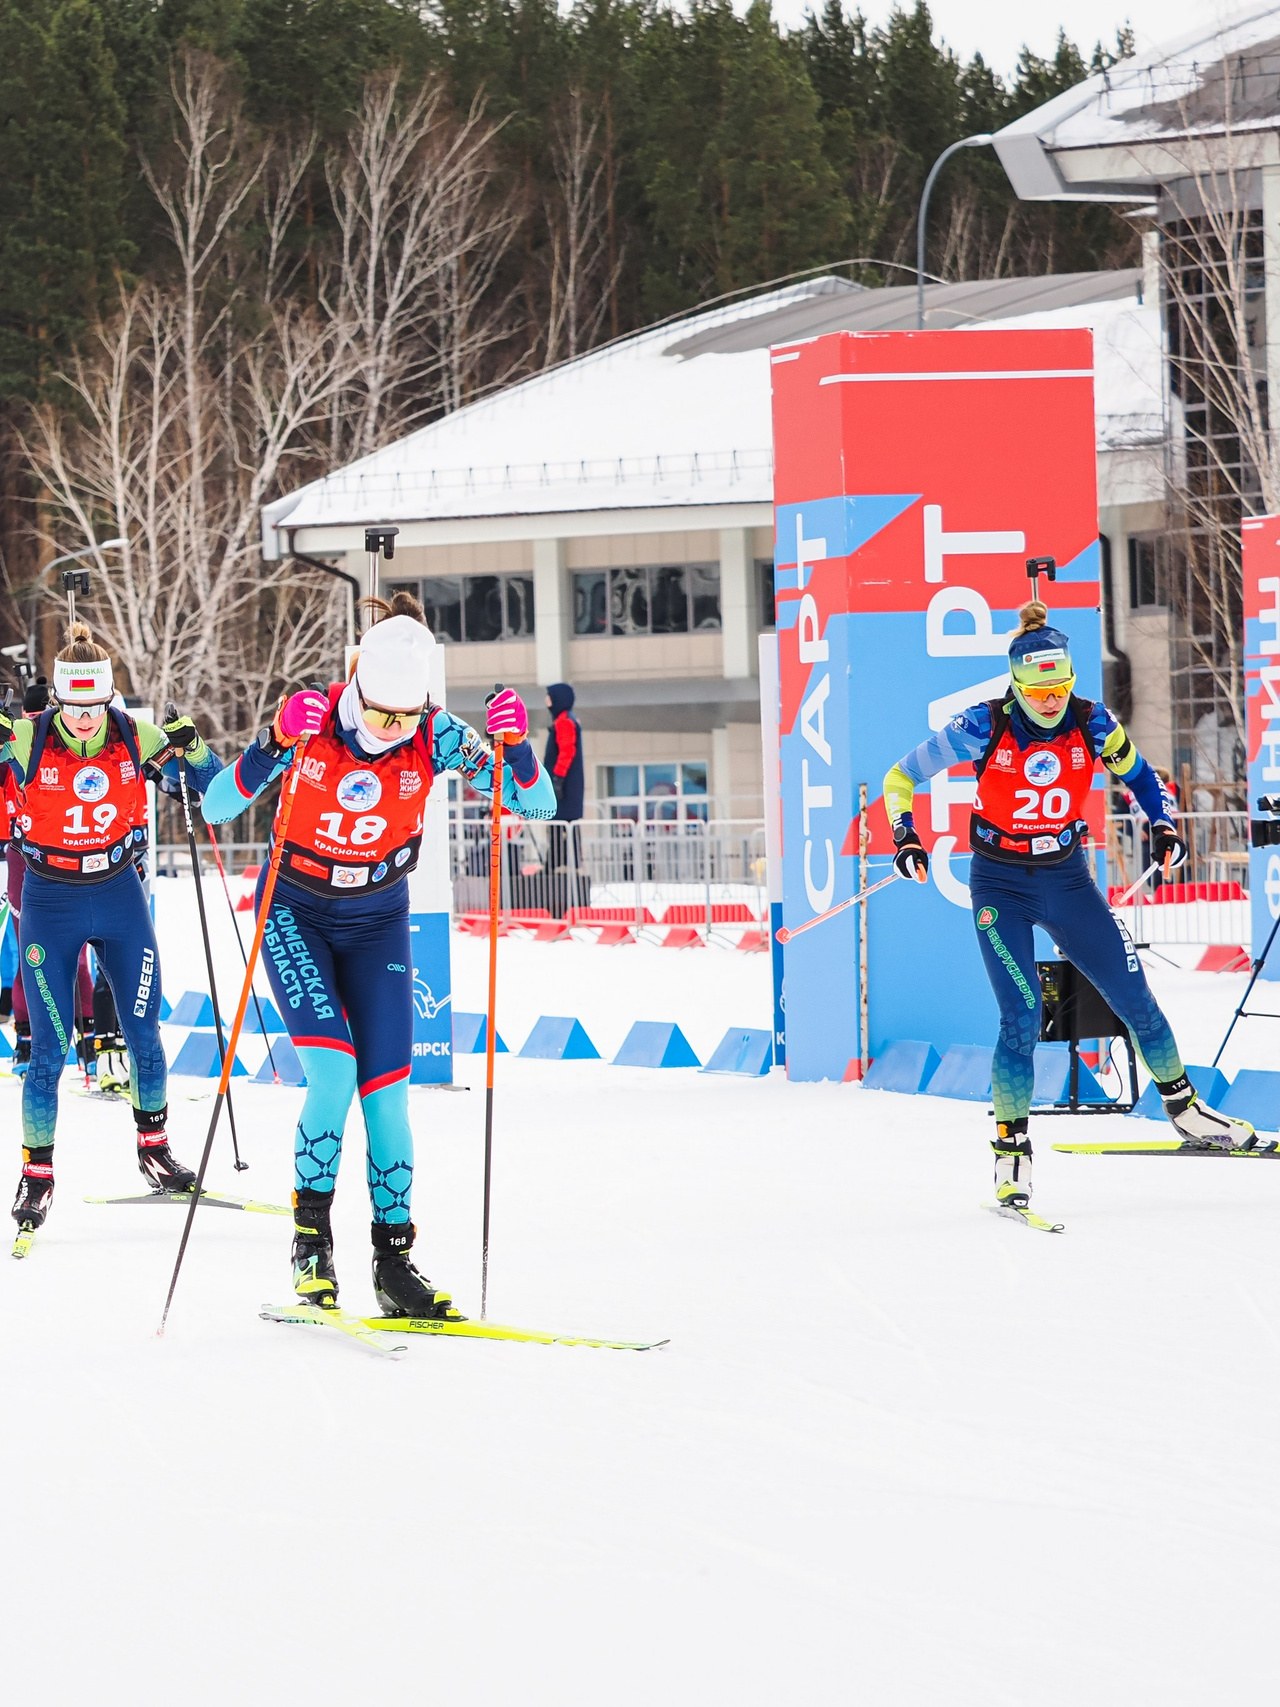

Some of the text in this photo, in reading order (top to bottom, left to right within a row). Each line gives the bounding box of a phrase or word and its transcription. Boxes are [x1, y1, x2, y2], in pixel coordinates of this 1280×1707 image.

[796, 513, 835, 914] СТАРТ
[63, 803, 118, 835] 19
[1012, 787, 1071, 820] 20
[315, 811, 388, 846] 18
[1012, 822, 1066, 831] КРАСНОЯРСК
[137, 948, 155, 1001] BEEU
[263, 918, 306, 1009] ОБЛАСТЬ
[987, 927, 1036, 1010] БЕЛОРУСНЕФТЬ
[34, 968, 69, 1055] БЕЛОРУСНЕФТЬ
[1172, 1079, 1186, 1091] 170
[389, 1236, 407, 1246] 168
[409, 1321, 445, 1330] FISCHER
